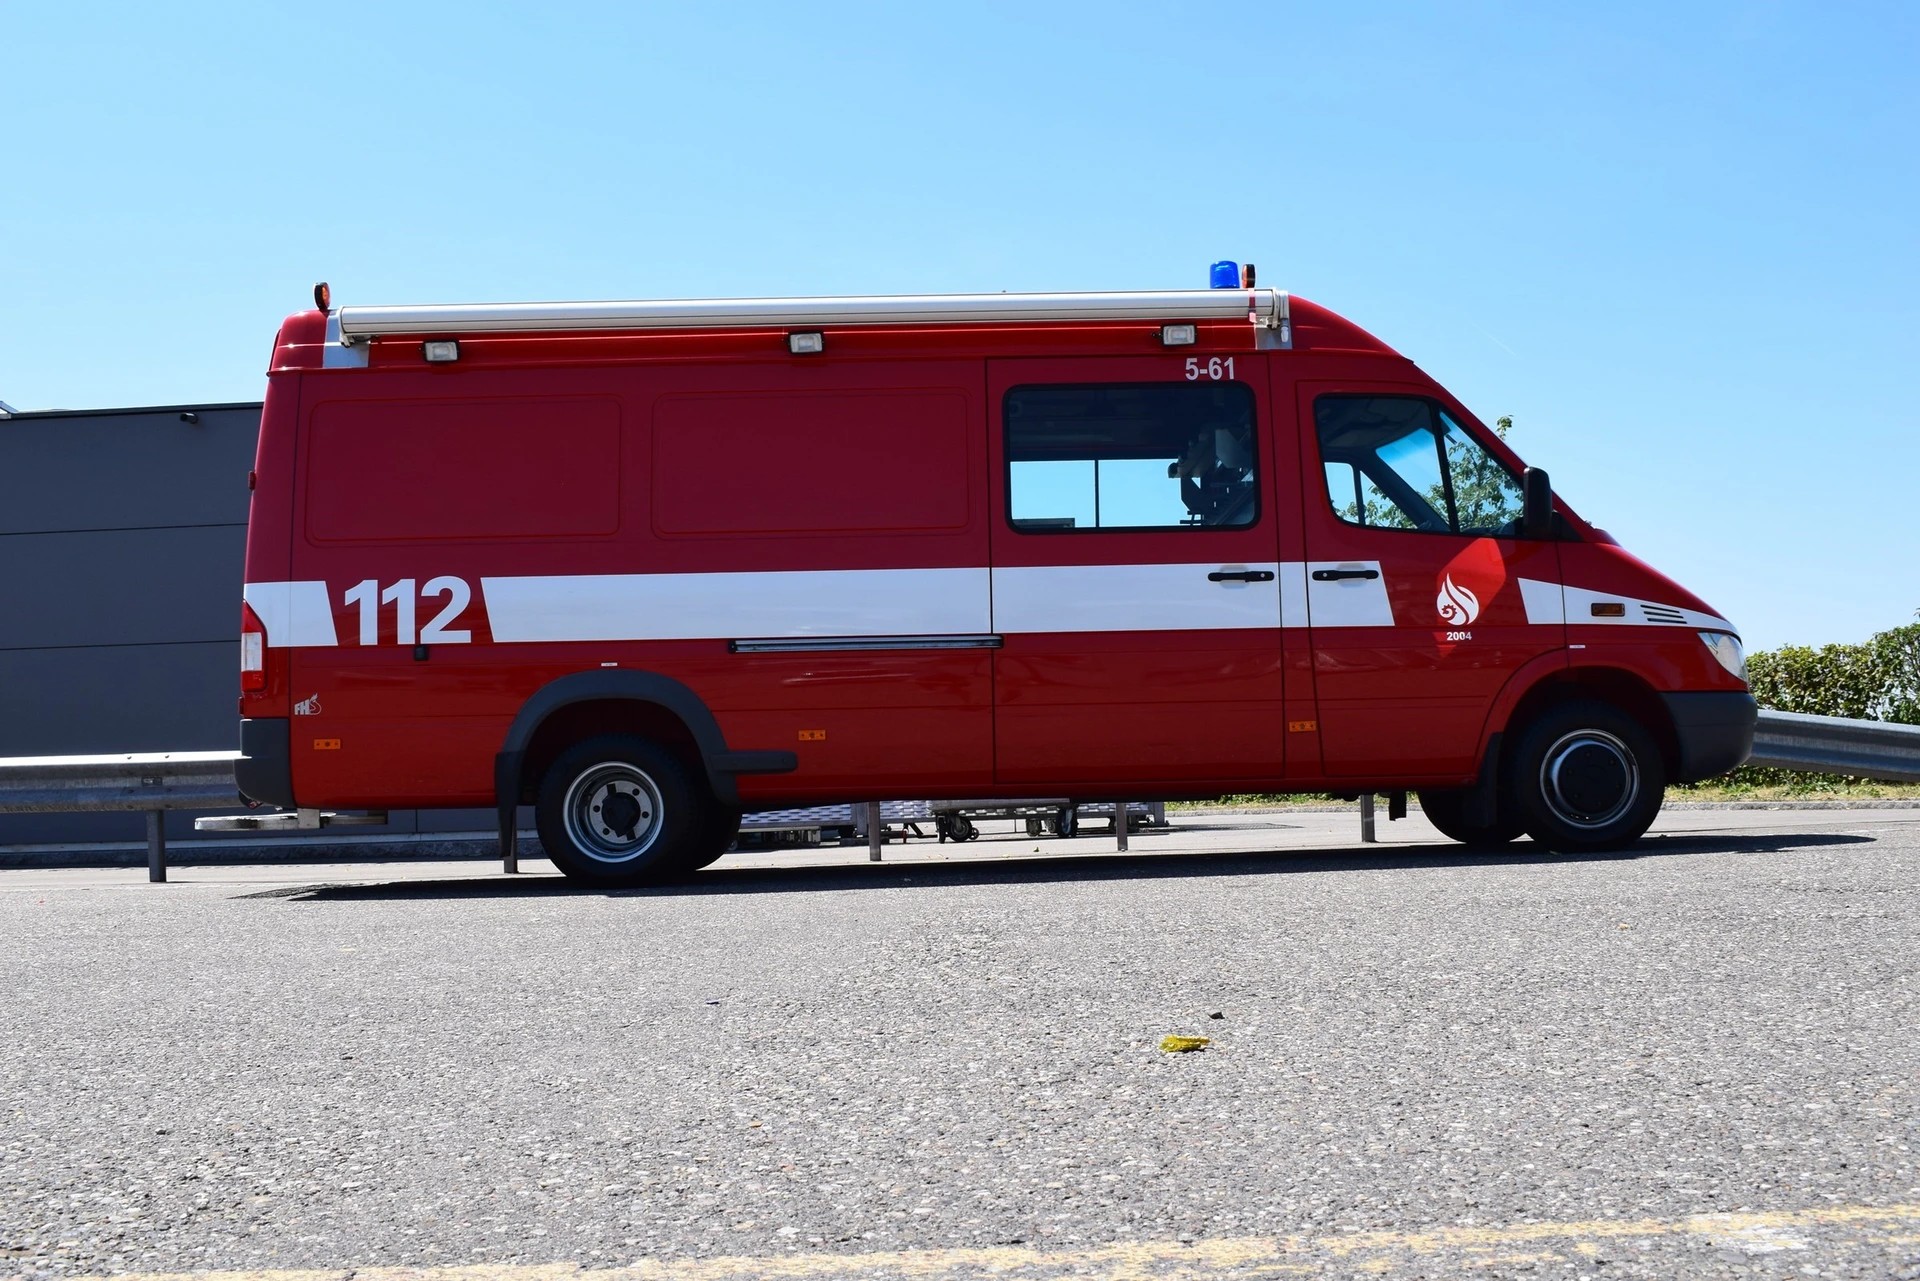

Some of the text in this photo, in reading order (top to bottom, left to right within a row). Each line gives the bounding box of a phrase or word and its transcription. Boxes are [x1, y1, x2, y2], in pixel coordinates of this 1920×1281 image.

[1185, 357, 1235, 381] 5-61
[344, 575, 472, 647] 112
[1446, 631, 1473, 641] 2004
